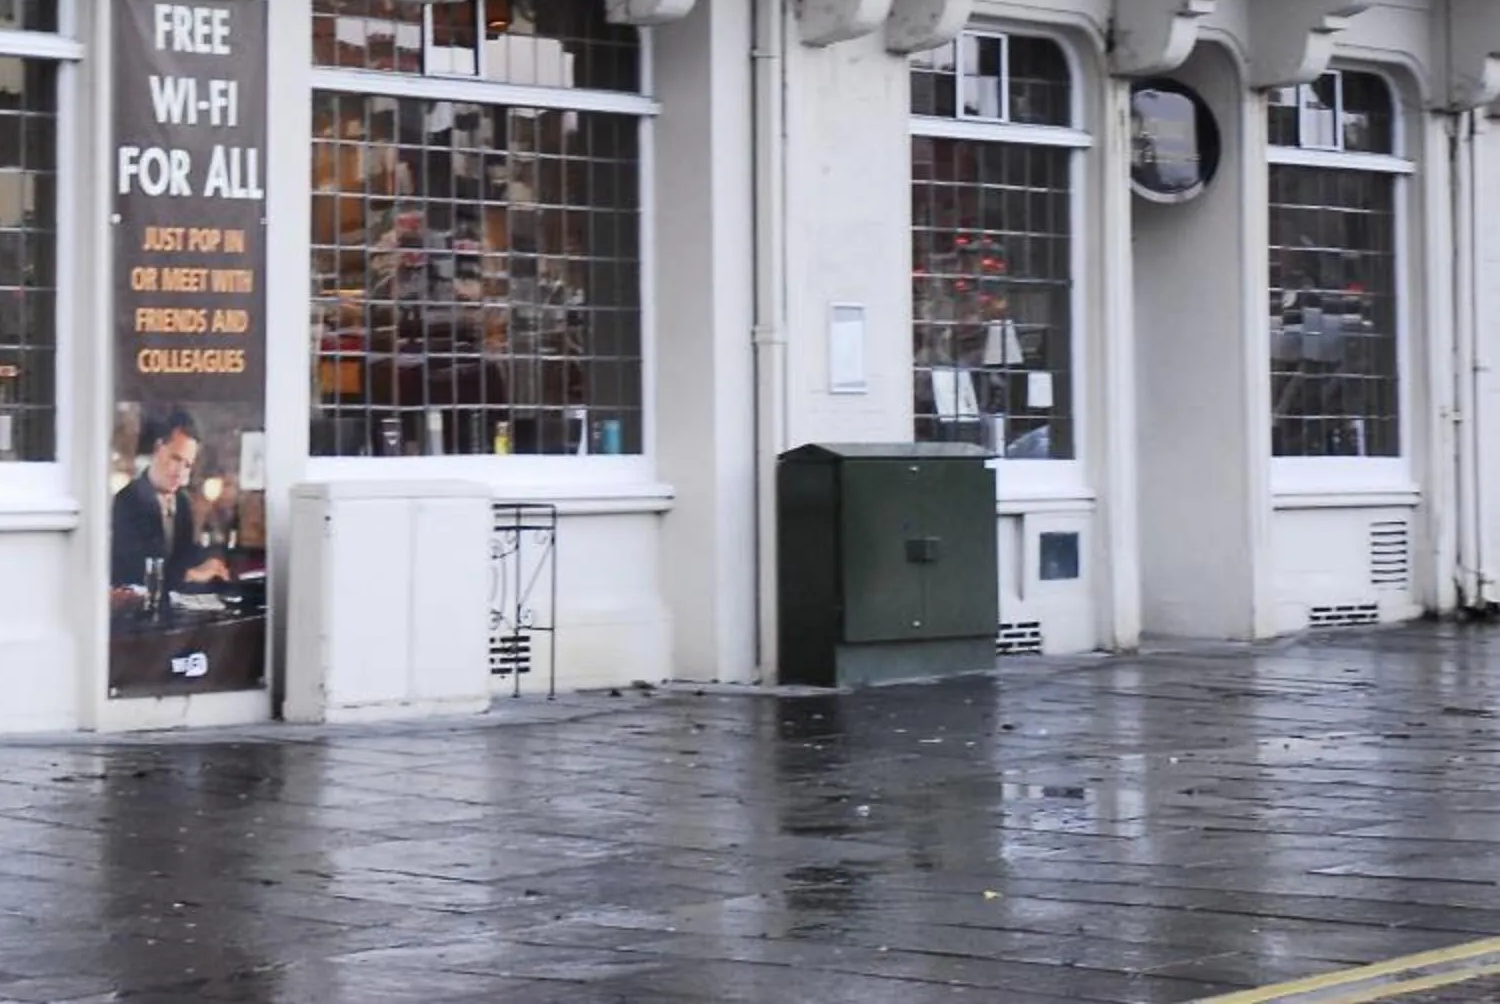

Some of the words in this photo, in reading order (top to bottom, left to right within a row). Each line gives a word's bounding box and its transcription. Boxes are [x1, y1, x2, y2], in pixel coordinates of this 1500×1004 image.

[154, 3, 231, 55] FREE
[148, 75, 238, 127] WI-FI
[118, 145, 192, 197] FOR
[203, 144, 264, 200] ALL
[142, 226, 186, 251] JUST
[188, 228, 221, 252] POP
[223, 229, 245, 253] IN
[131, 267, 158, 291] OR
[161, 268, 208, 292] MEET
[211, 269, 253, 293] WITH
[135, 307, 208, 333] FRIENDS
[211, 309, 249, 333] AND
